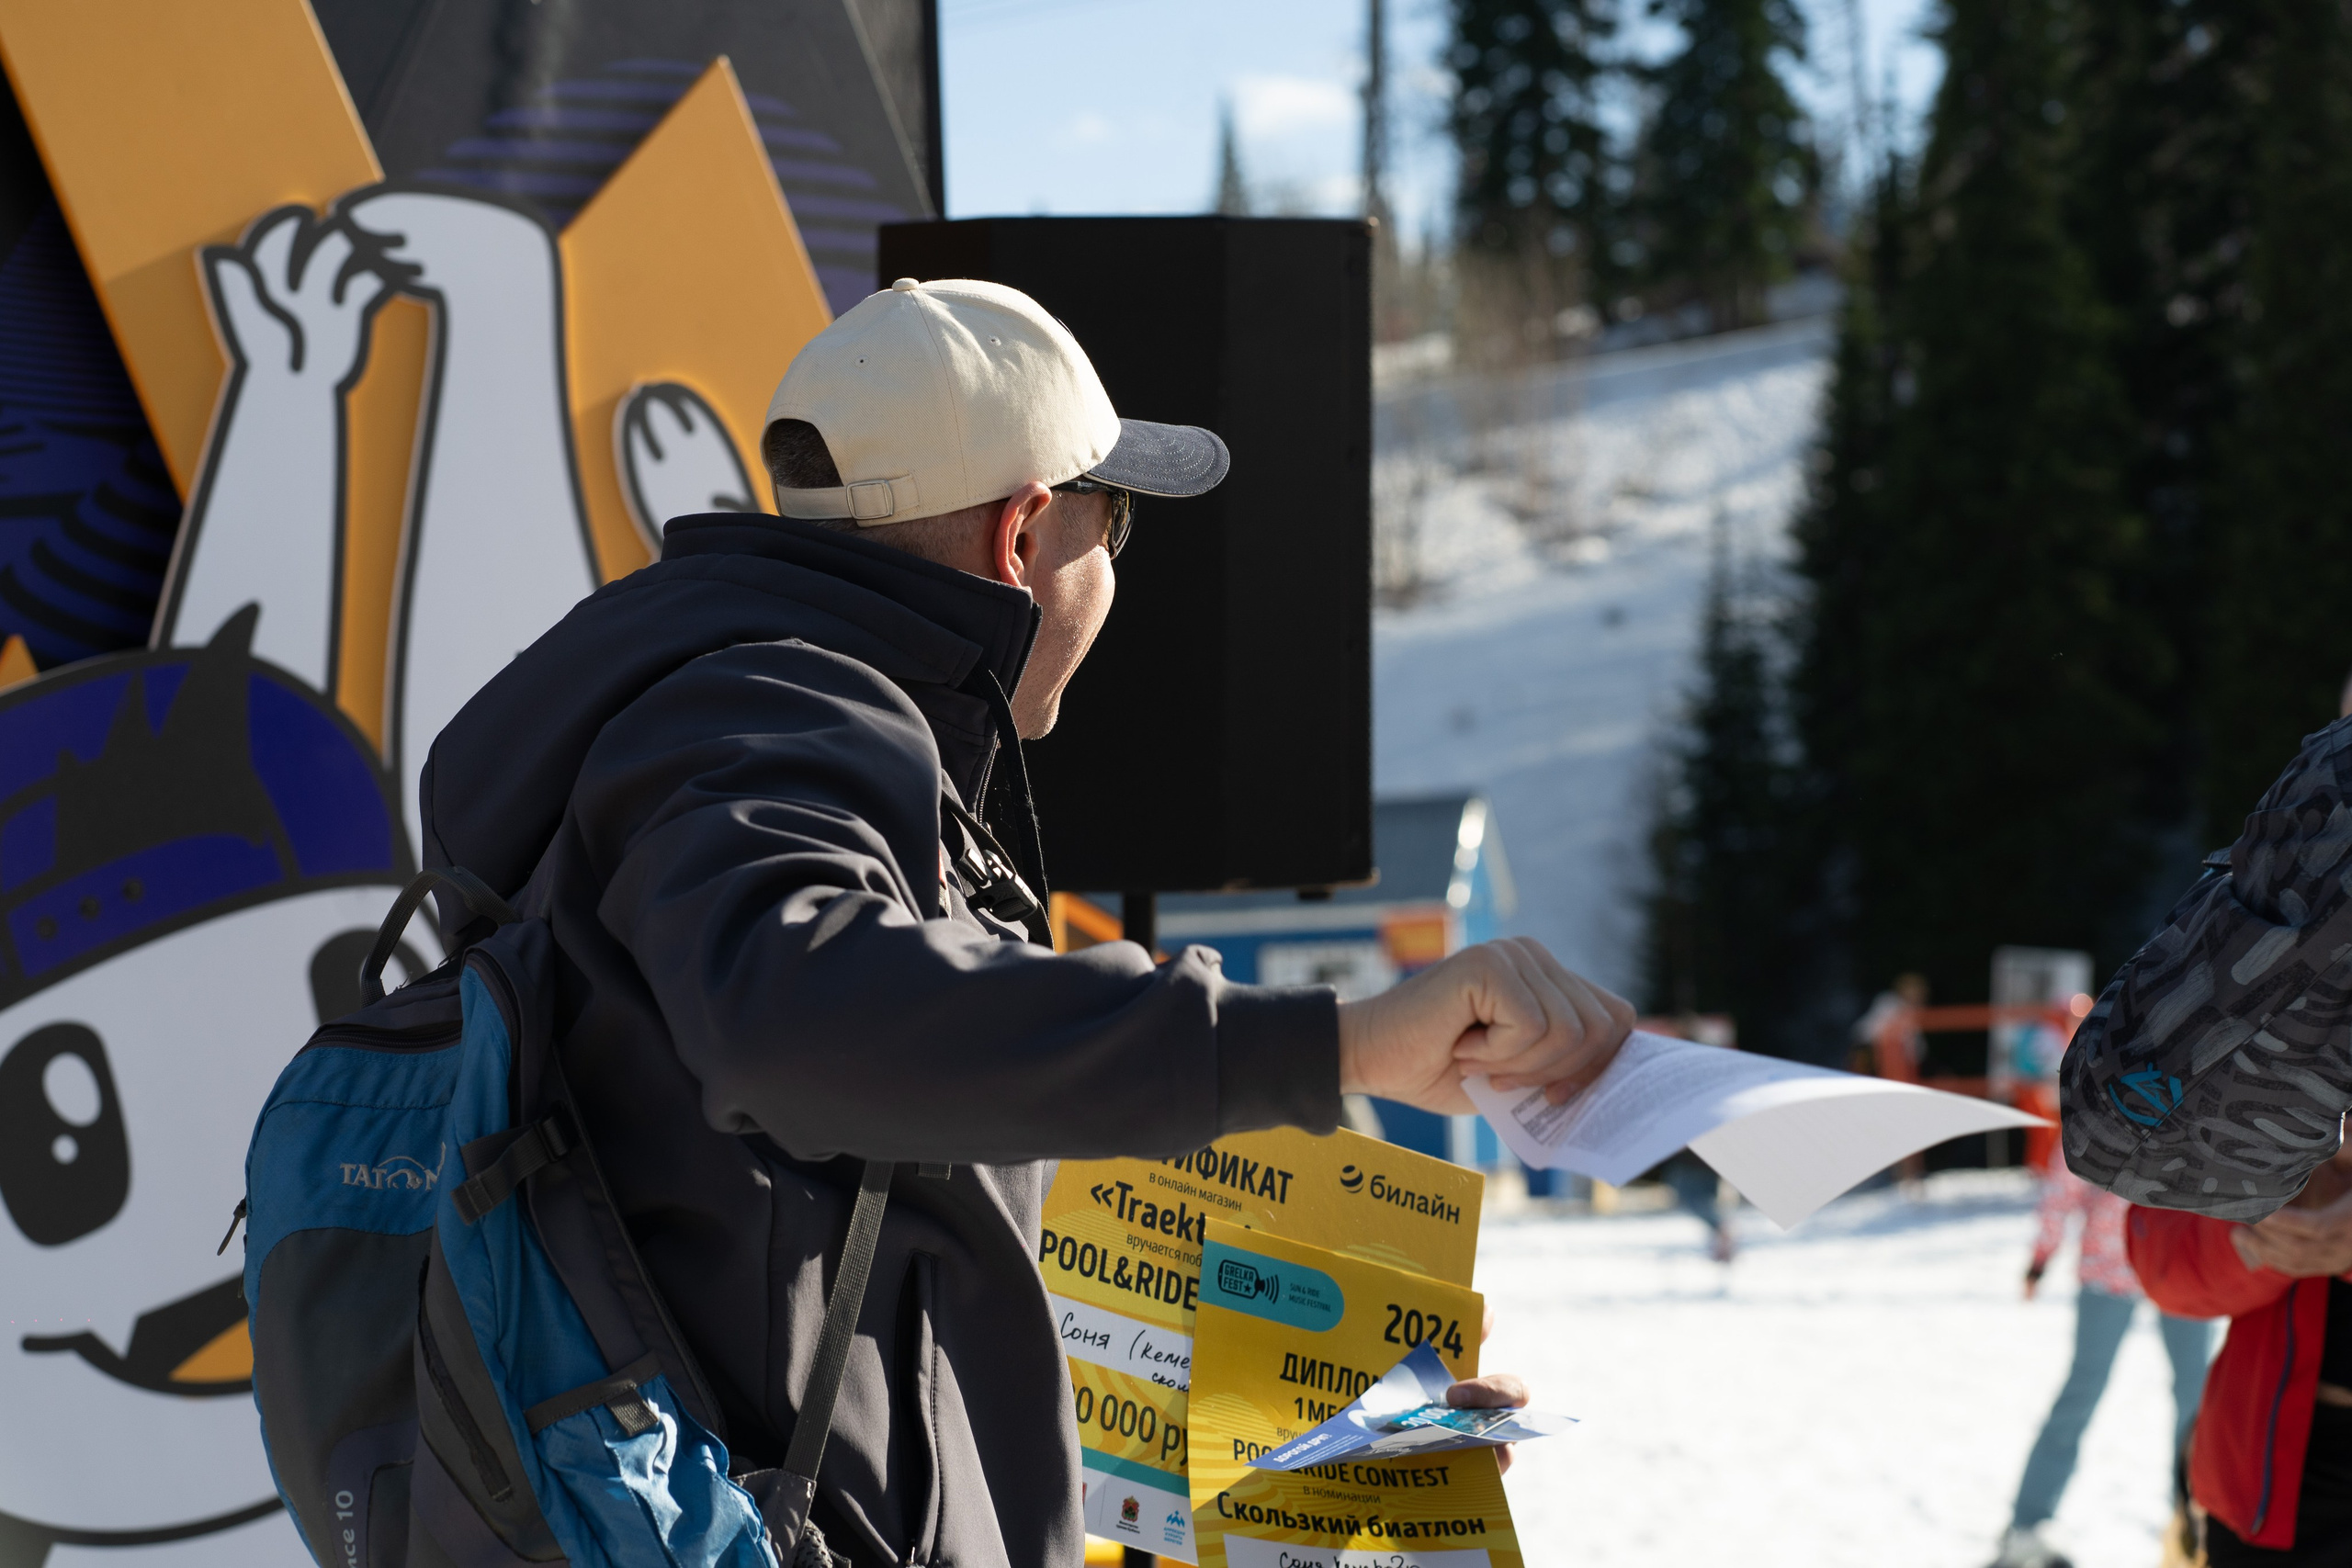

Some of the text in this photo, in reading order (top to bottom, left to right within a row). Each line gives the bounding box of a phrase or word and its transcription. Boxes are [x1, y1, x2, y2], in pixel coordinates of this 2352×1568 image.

[1149, 1172, 1242, 1212] в онлайн магазин
[1161, 1145, 1294, 1204] ИФИКАТ
[1370, 1175, 1460, 1224] билайн
[1126, 1234, 1181, 1260] вручается
[1039, 1229, 1199, 1312] POOL&RIDE
[1223, 1277, 1243, 1292] FEST
[1224, 1264, 1254, 1282] GRELKA
[1060, 1312, 1111, 1350] Соня
[1385, 1303, 1463, 1359] 2024
[1279, 1352, 1380, 1398] ДИПЛО
[1101, 1394, 1156, 1443] 000
[1307, 1399, 1345, 1425] МЕ
[1312, 1486, 1381, 1505] номинации
[1353, 1465, 1450, 1487] CONTEST
[335, 1490, 354, 1521] 10
[1217, 1491, 1486, 1538] Скользкий биатлон
